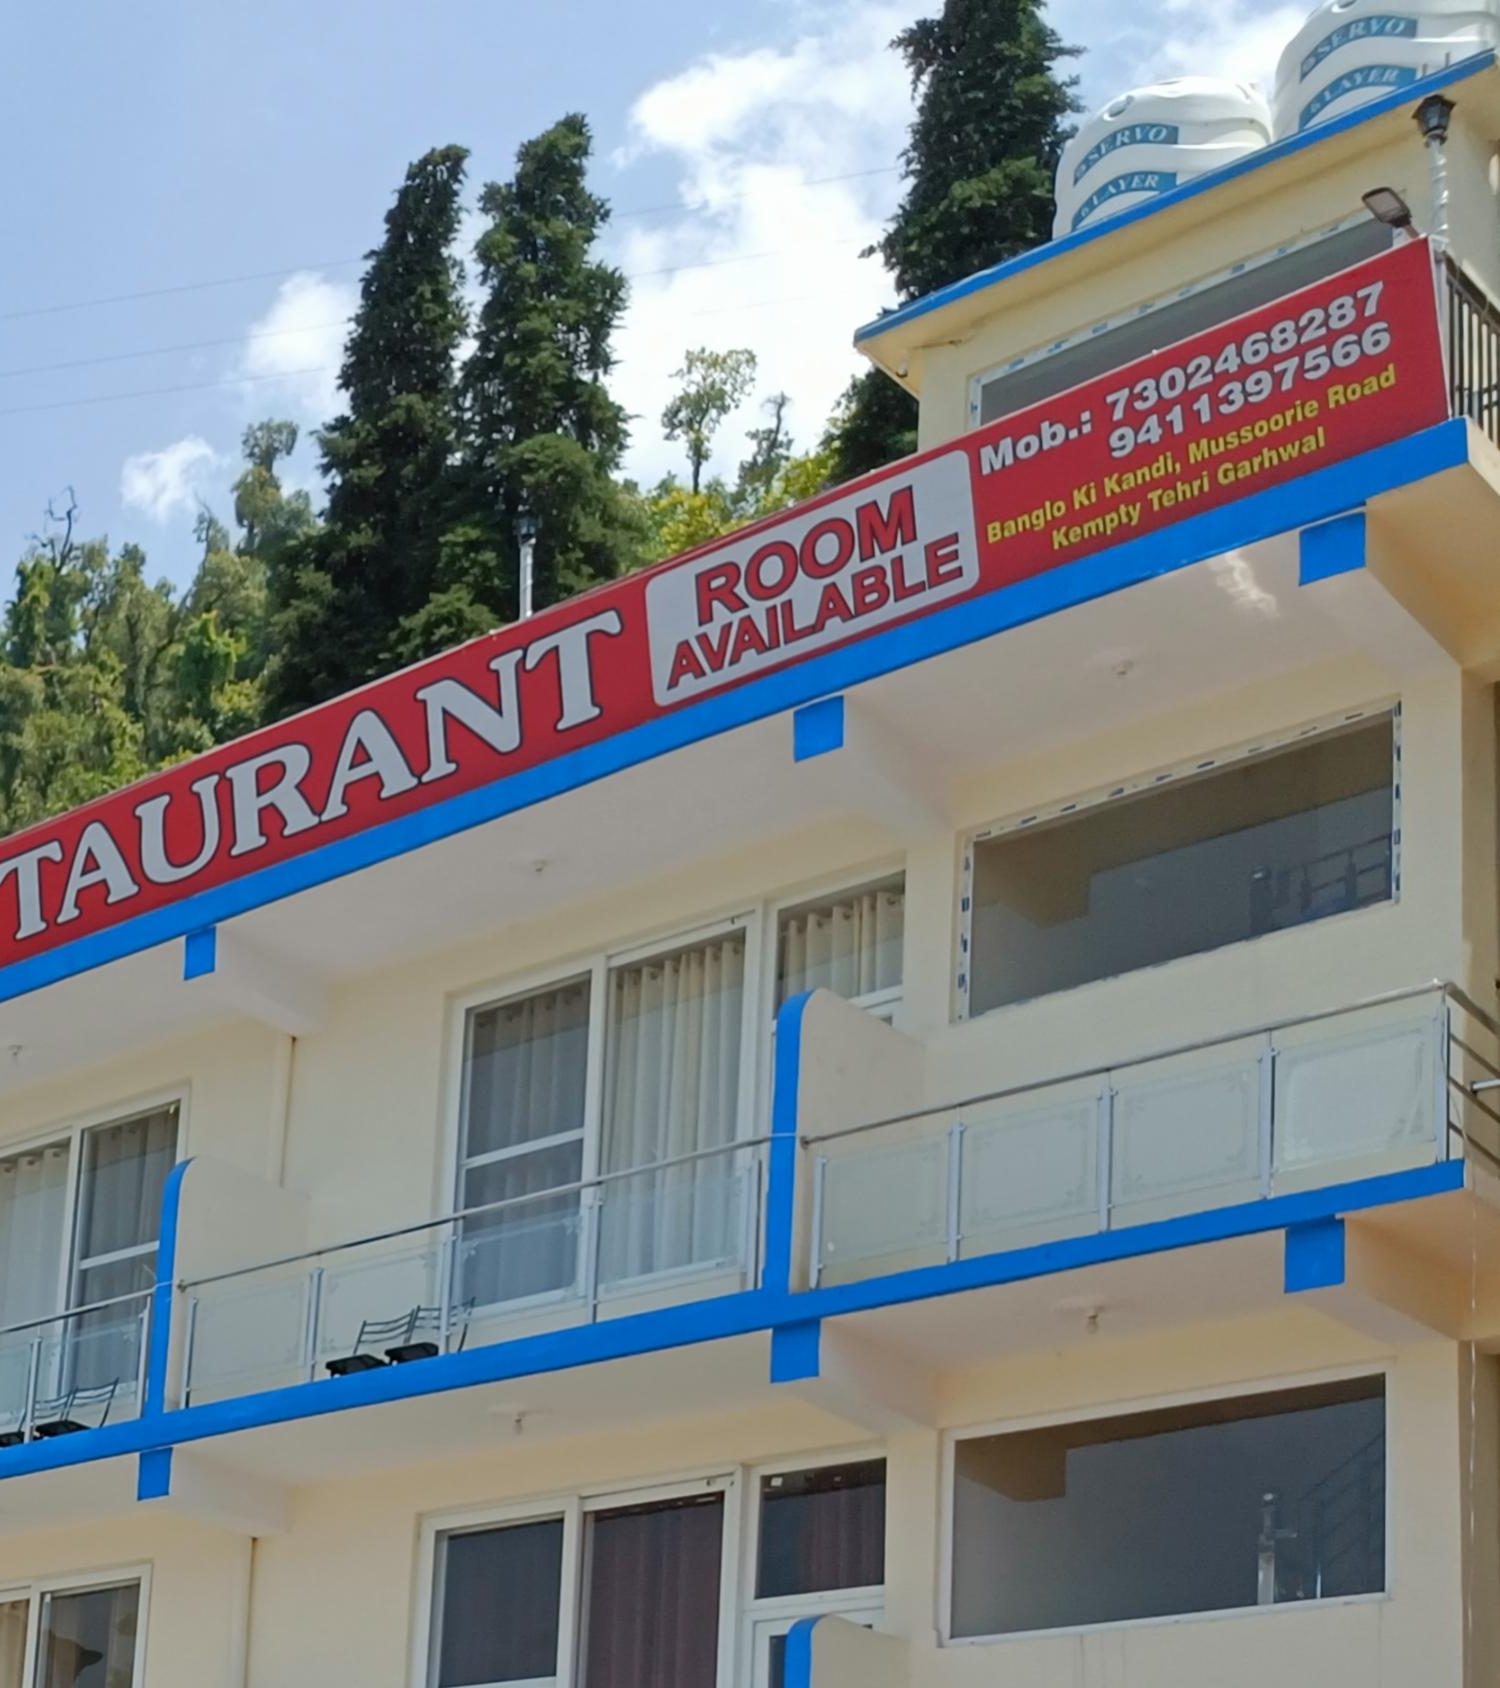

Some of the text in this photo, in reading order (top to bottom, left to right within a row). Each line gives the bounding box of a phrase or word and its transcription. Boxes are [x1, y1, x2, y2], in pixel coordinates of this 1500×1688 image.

[1105, 280, 1386, 423] 7302468287
[1108, 320, 1392, 459] 9411397566
[986, 362, 1397, 545] Banglo Ki Kandi, Mussoorie Road
[1051, 426, 1326, 551] Kempty Tehri Garhwal
[666, 532, 965, 692] AVAILABLE
[694, 484, 918, 628] ROOM
